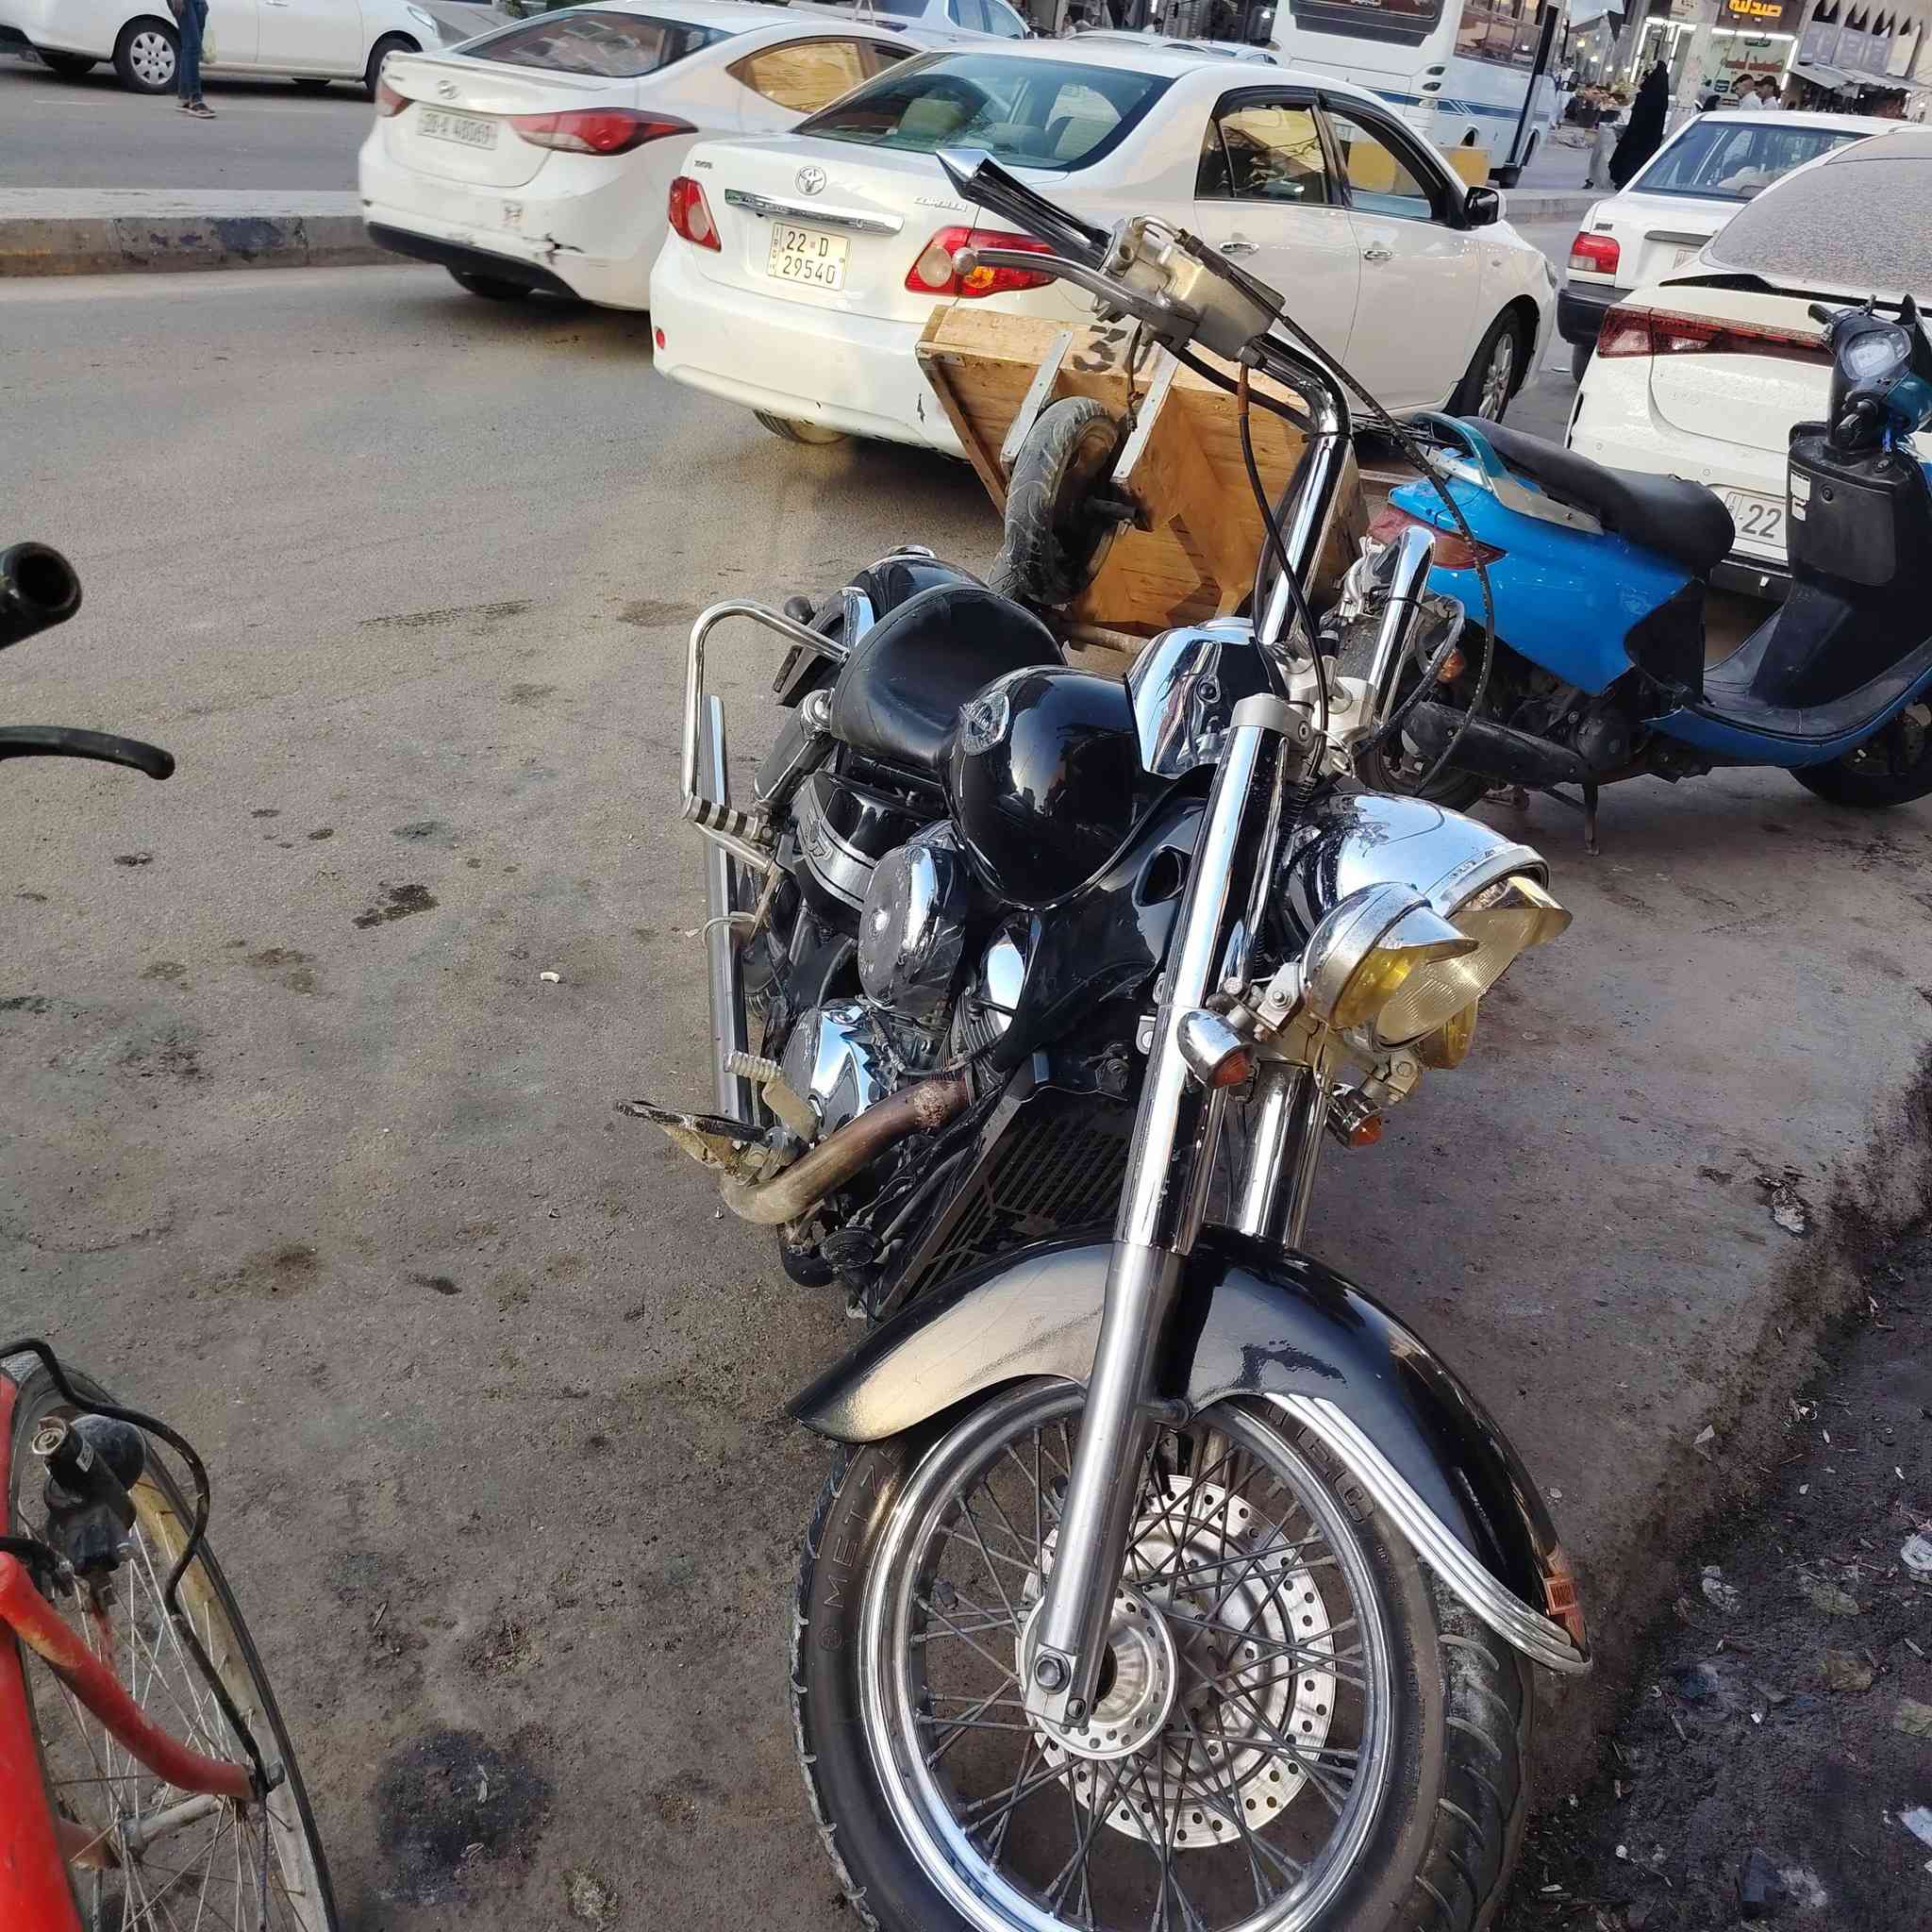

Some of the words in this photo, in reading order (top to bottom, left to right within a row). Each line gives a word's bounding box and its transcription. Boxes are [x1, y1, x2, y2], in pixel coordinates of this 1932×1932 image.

[786, 230, 807, 253] 22
[818, 237, 829, 258] D
[782, 255, 836, 285] 29540
[1741, 504, 1782, 539] 22
